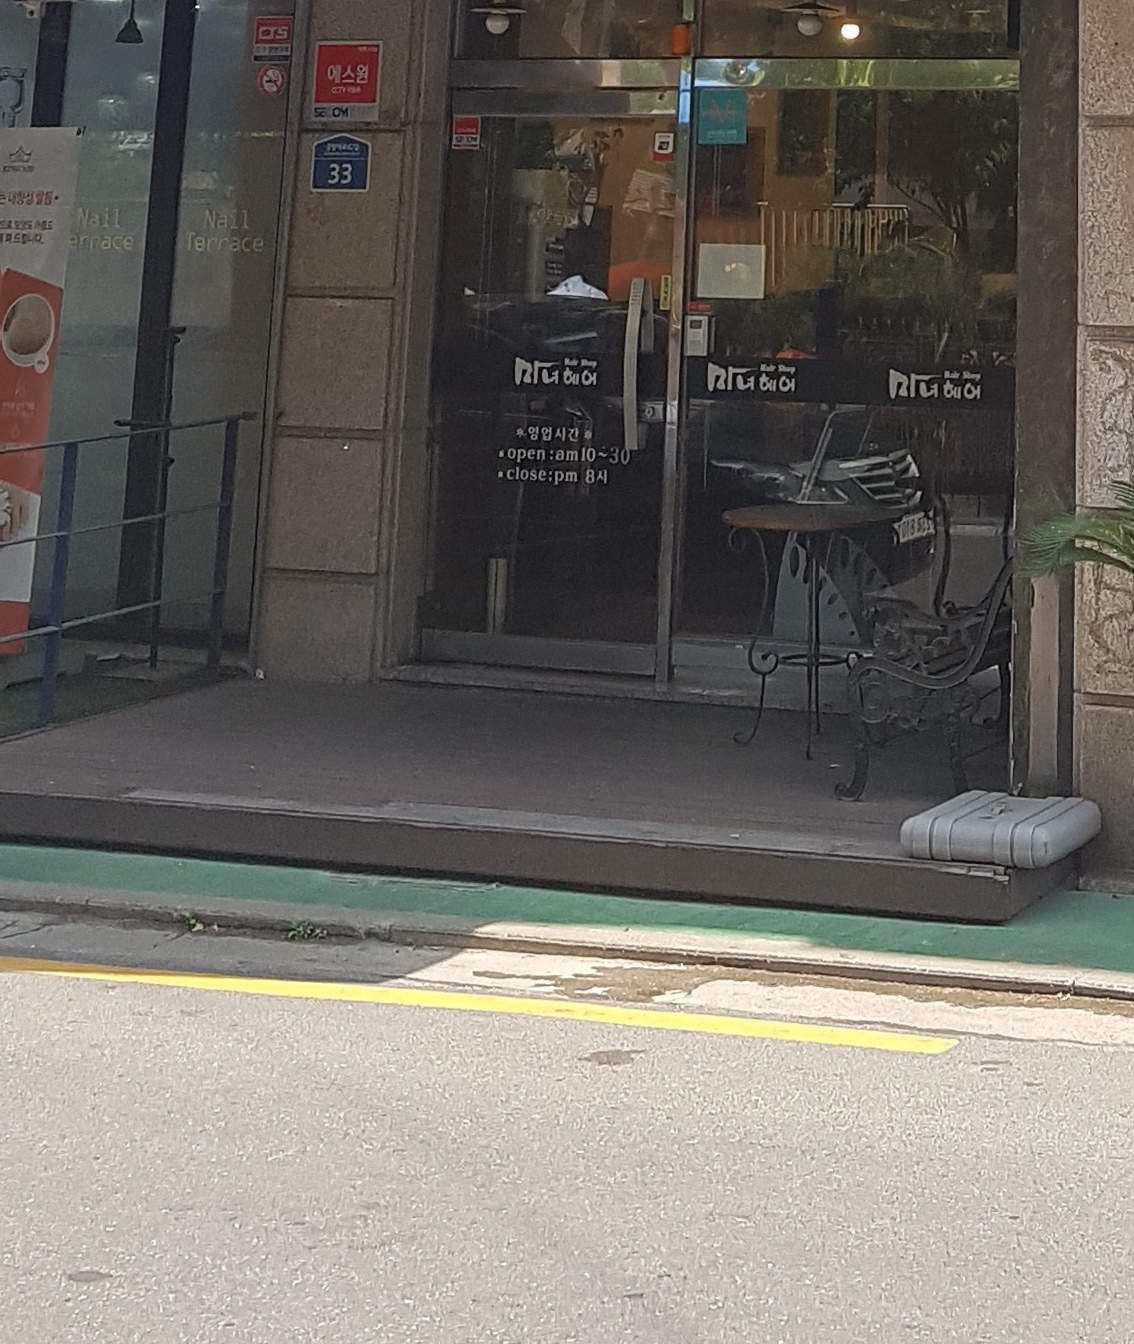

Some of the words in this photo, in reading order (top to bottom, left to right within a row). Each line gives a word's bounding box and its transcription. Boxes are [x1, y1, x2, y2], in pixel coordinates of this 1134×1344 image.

[327, 64, 369, 84] 에스원
[327, 162, 353, 185] 33
[78, 208, 121, 228] Nail
[204, 209, 249, 229] Nail
[69, 234, 134, 250] errace
[187, 232, 264, 252] Terrace
